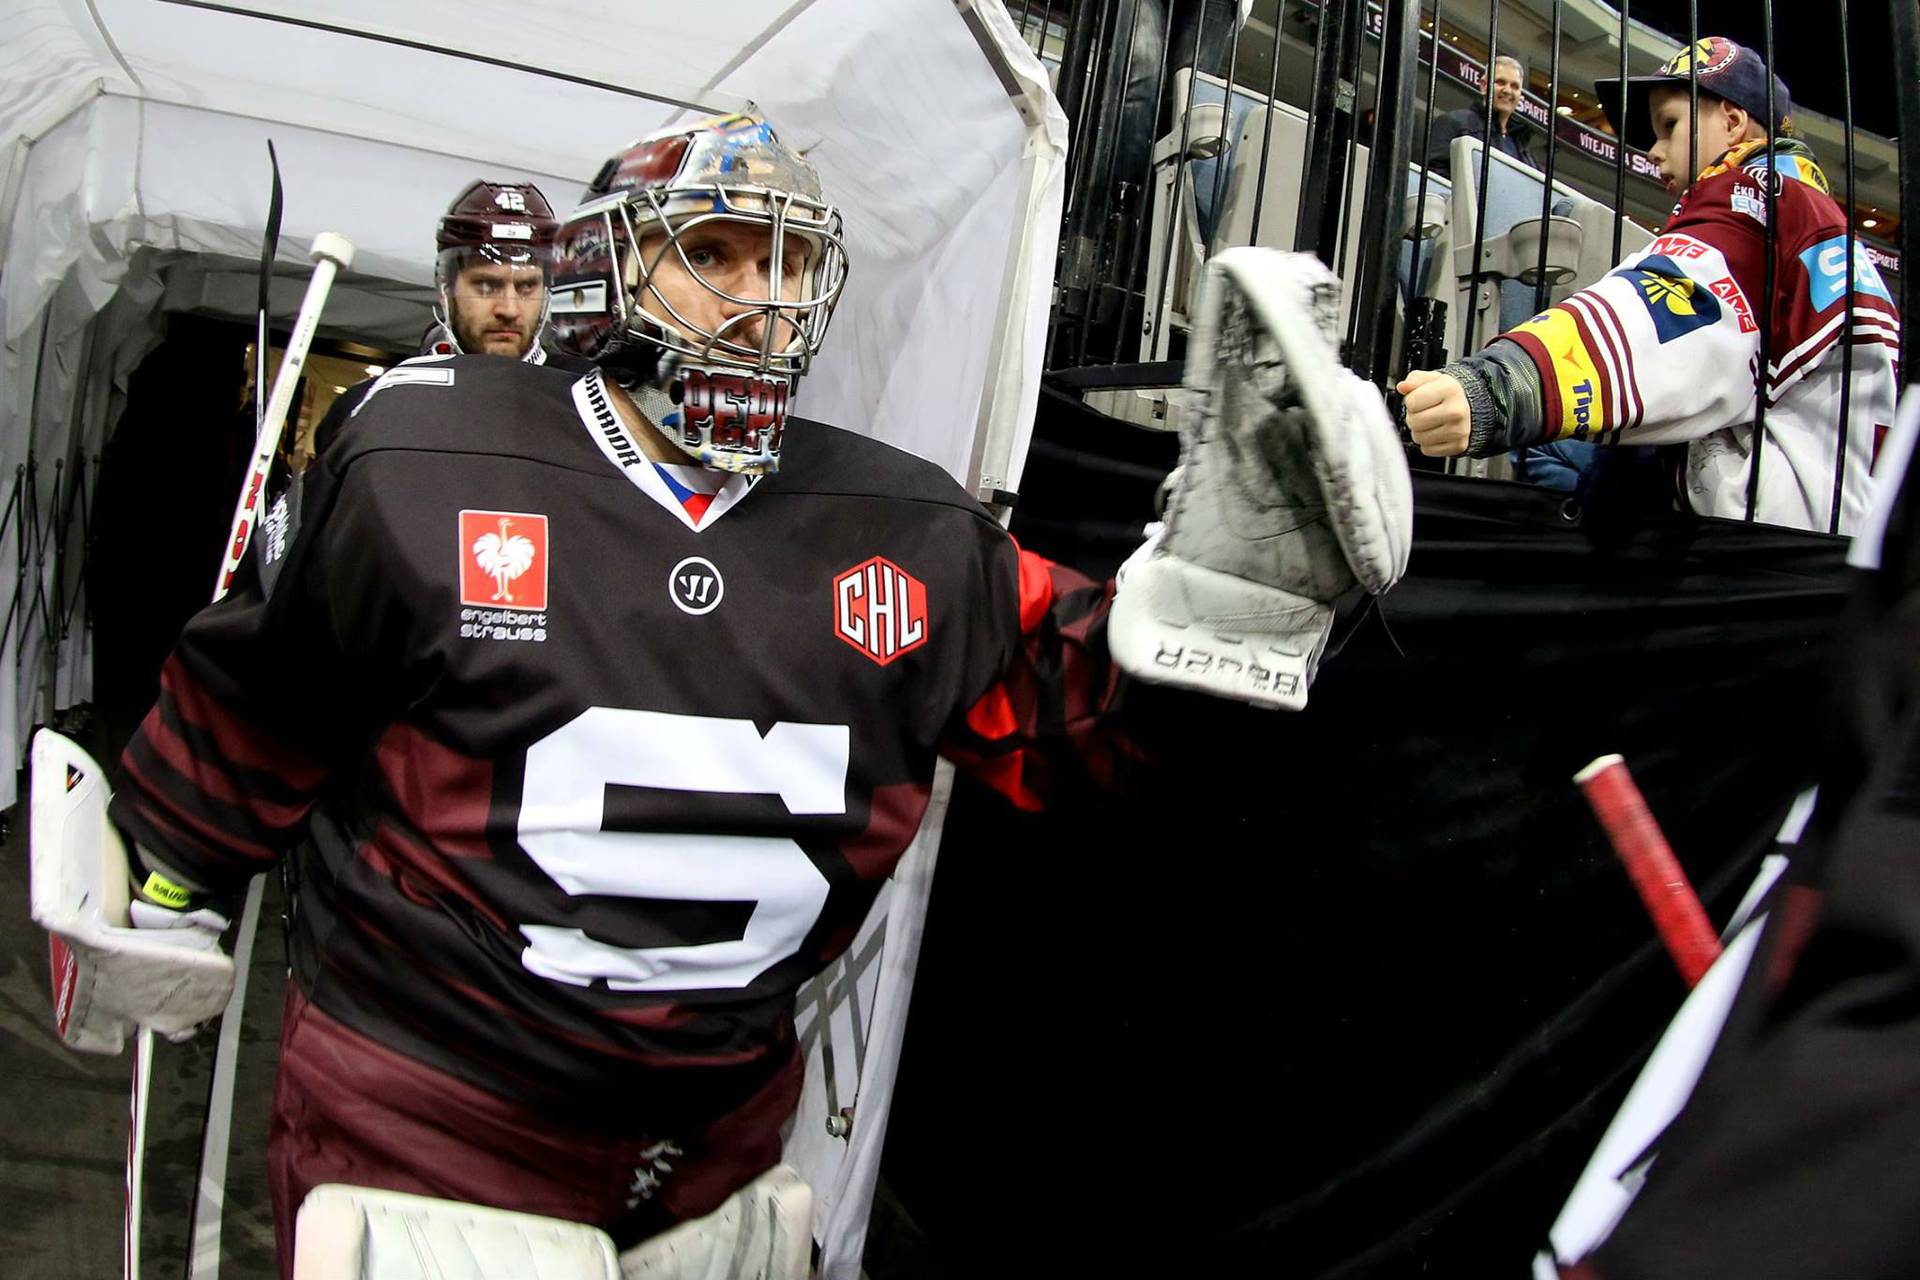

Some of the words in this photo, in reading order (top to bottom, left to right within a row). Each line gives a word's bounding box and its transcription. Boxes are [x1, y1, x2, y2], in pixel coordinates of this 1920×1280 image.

[1632, 154, 1662, 179] SPAR
[461, 608, 547, 627] engelbert
[839, 563, 923, 657] CHL
[460, 623, 547, 642] strauss
